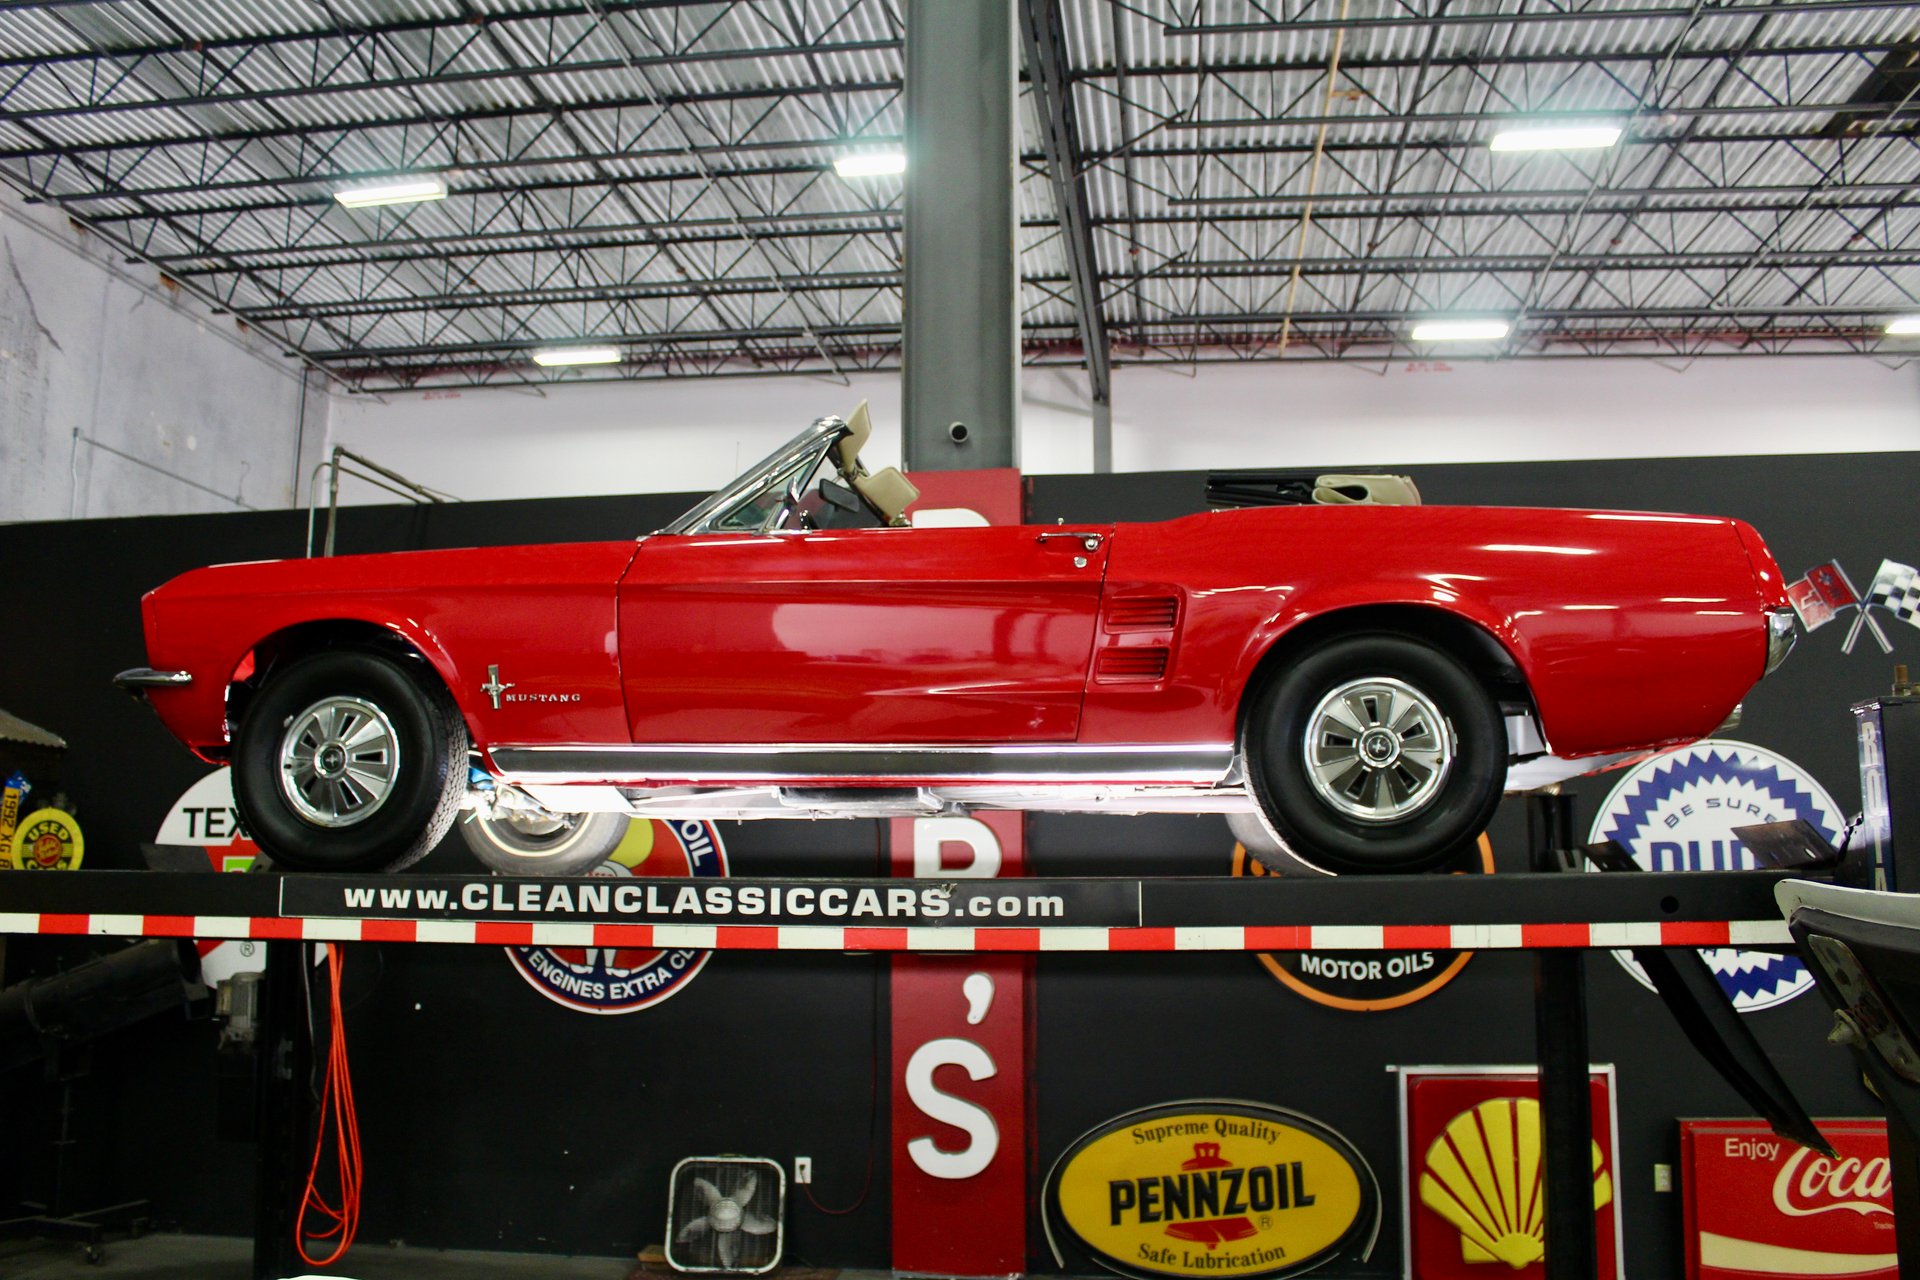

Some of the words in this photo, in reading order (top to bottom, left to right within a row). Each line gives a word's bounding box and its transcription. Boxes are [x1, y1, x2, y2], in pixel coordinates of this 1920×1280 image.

[506, 693, 581, 702] MUSTANG
[1664, 804, 1694, 828] BE
[28, 822, 70, 841] USED
[681, 819, 713, 867] OIL
[344, 883, 1064, 917] www.CLEANCLASSICCARS.com
[528, 951, 595, 999] ENGINES
[609, 966, 673, 1000] EXTRA
[1301, 953, 1382, 981] MOTOR
[1387, 951, 1434, 978] OILS
[1132, 1118, 1209, 1145] Supreme
[1214, 1118, 1281, 1145] Quality
[1725, 1137, 1780, 1161] Enjoy
[1109, 1161, 1316, 1226] PENNZOIL
[1137, 1243, 1177, 1266] Safe
[1183, 1246, 1286, 1270] Lubrication
